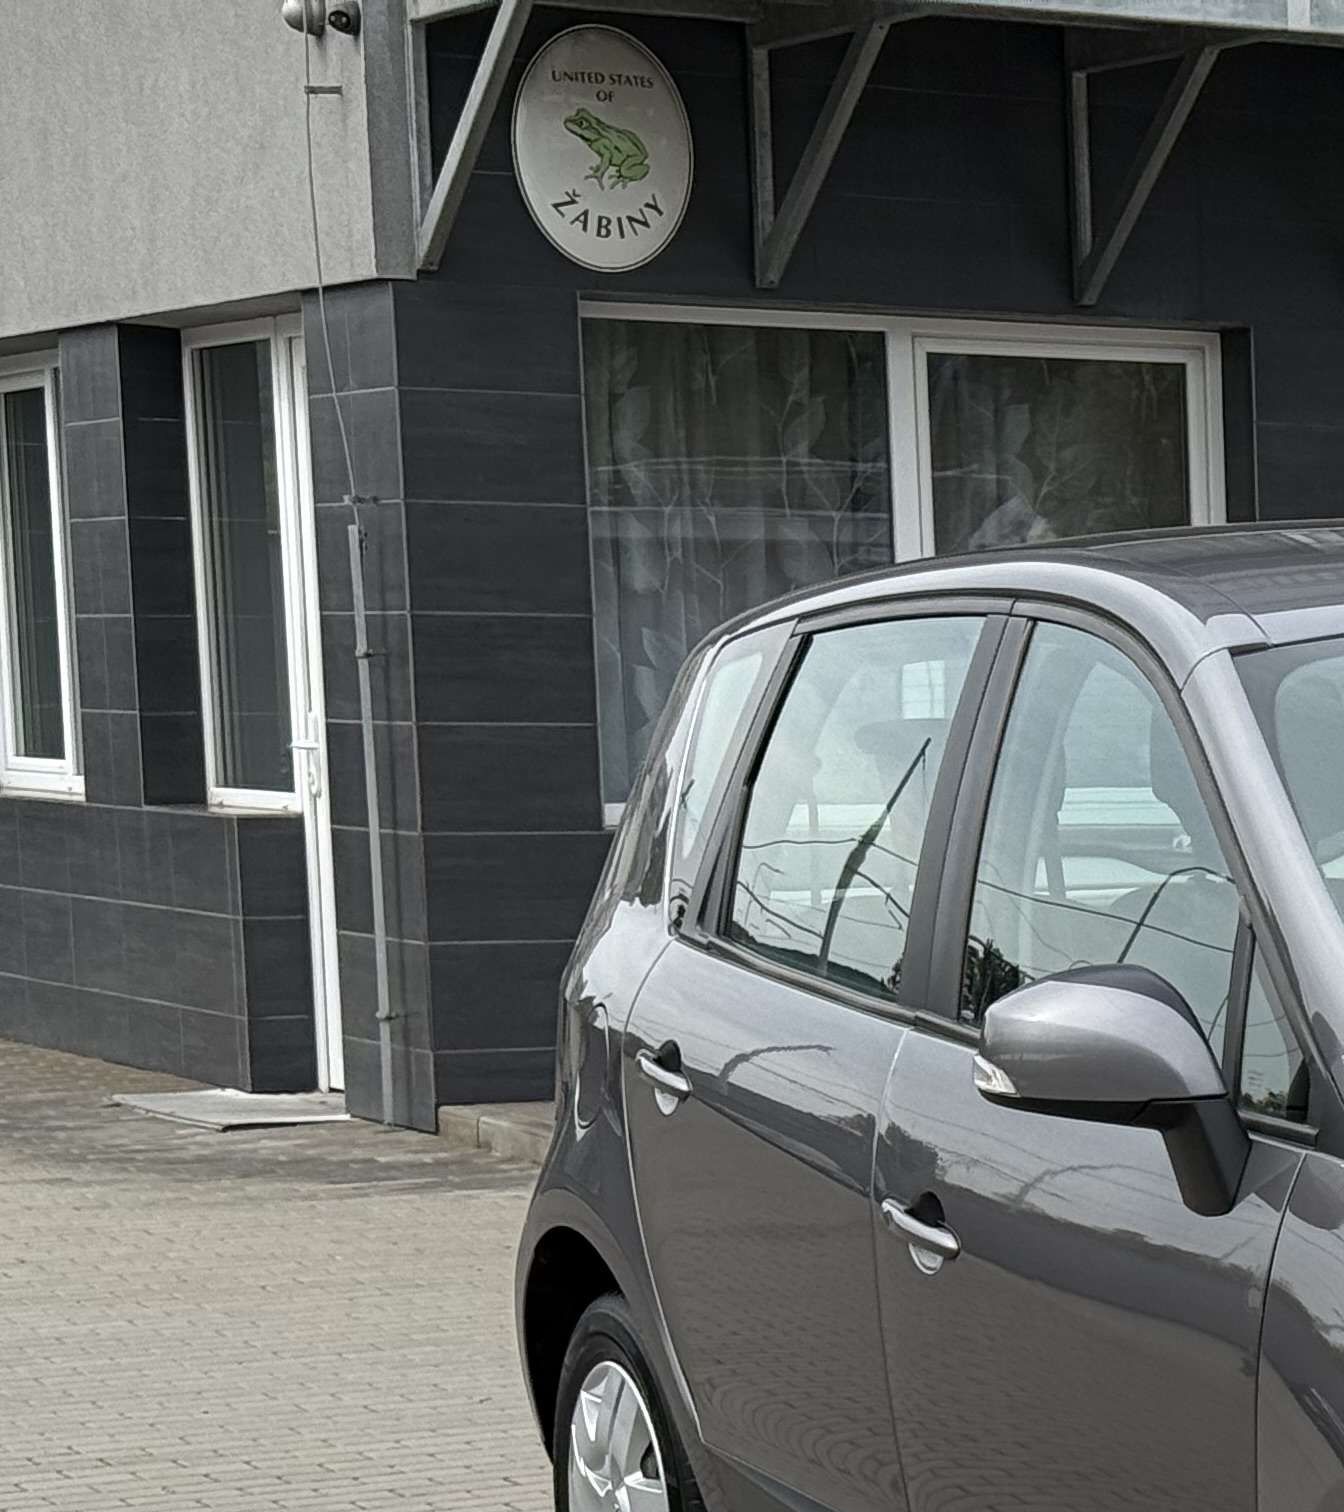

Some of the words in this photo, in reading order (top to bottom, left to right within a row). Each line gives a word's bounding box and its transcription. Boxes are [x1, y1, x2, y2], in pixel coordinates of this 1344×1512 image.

[551, 69, 605, 85] UNITED
[609, 73, 654, 89] STATES
[595, 89, 615, 102] OF
[551, 188, 664, 239] ŽABINY
